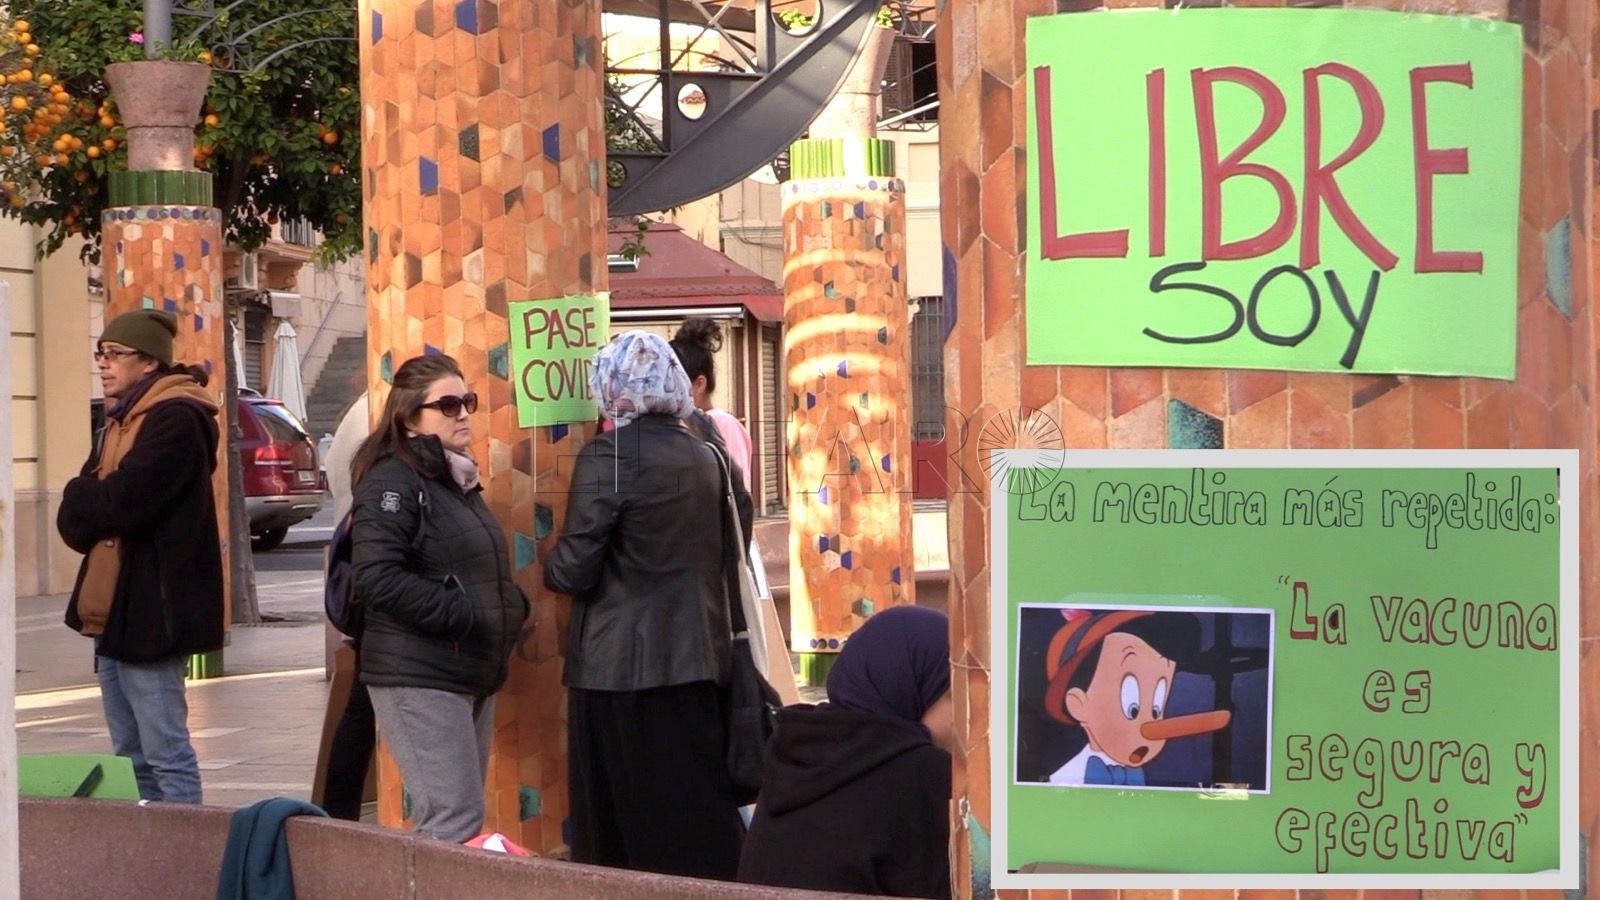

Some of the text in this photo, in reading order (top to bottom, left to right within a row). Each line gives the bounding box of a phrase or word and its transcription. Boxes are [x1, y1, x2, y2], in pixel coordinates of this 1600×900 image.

[1033, 62, 1484, 275] LIBRE
[522, 307, 597, 350] PASE
[1143, 262, 1381, 369] SOY
[1018, 467, 1556, 550] La mentira más repetida:
[1369, 594, 1559, 651] vacuna
[1362, 668, 1432, 715] es
[1285, 732, 1548, 809] segura y
